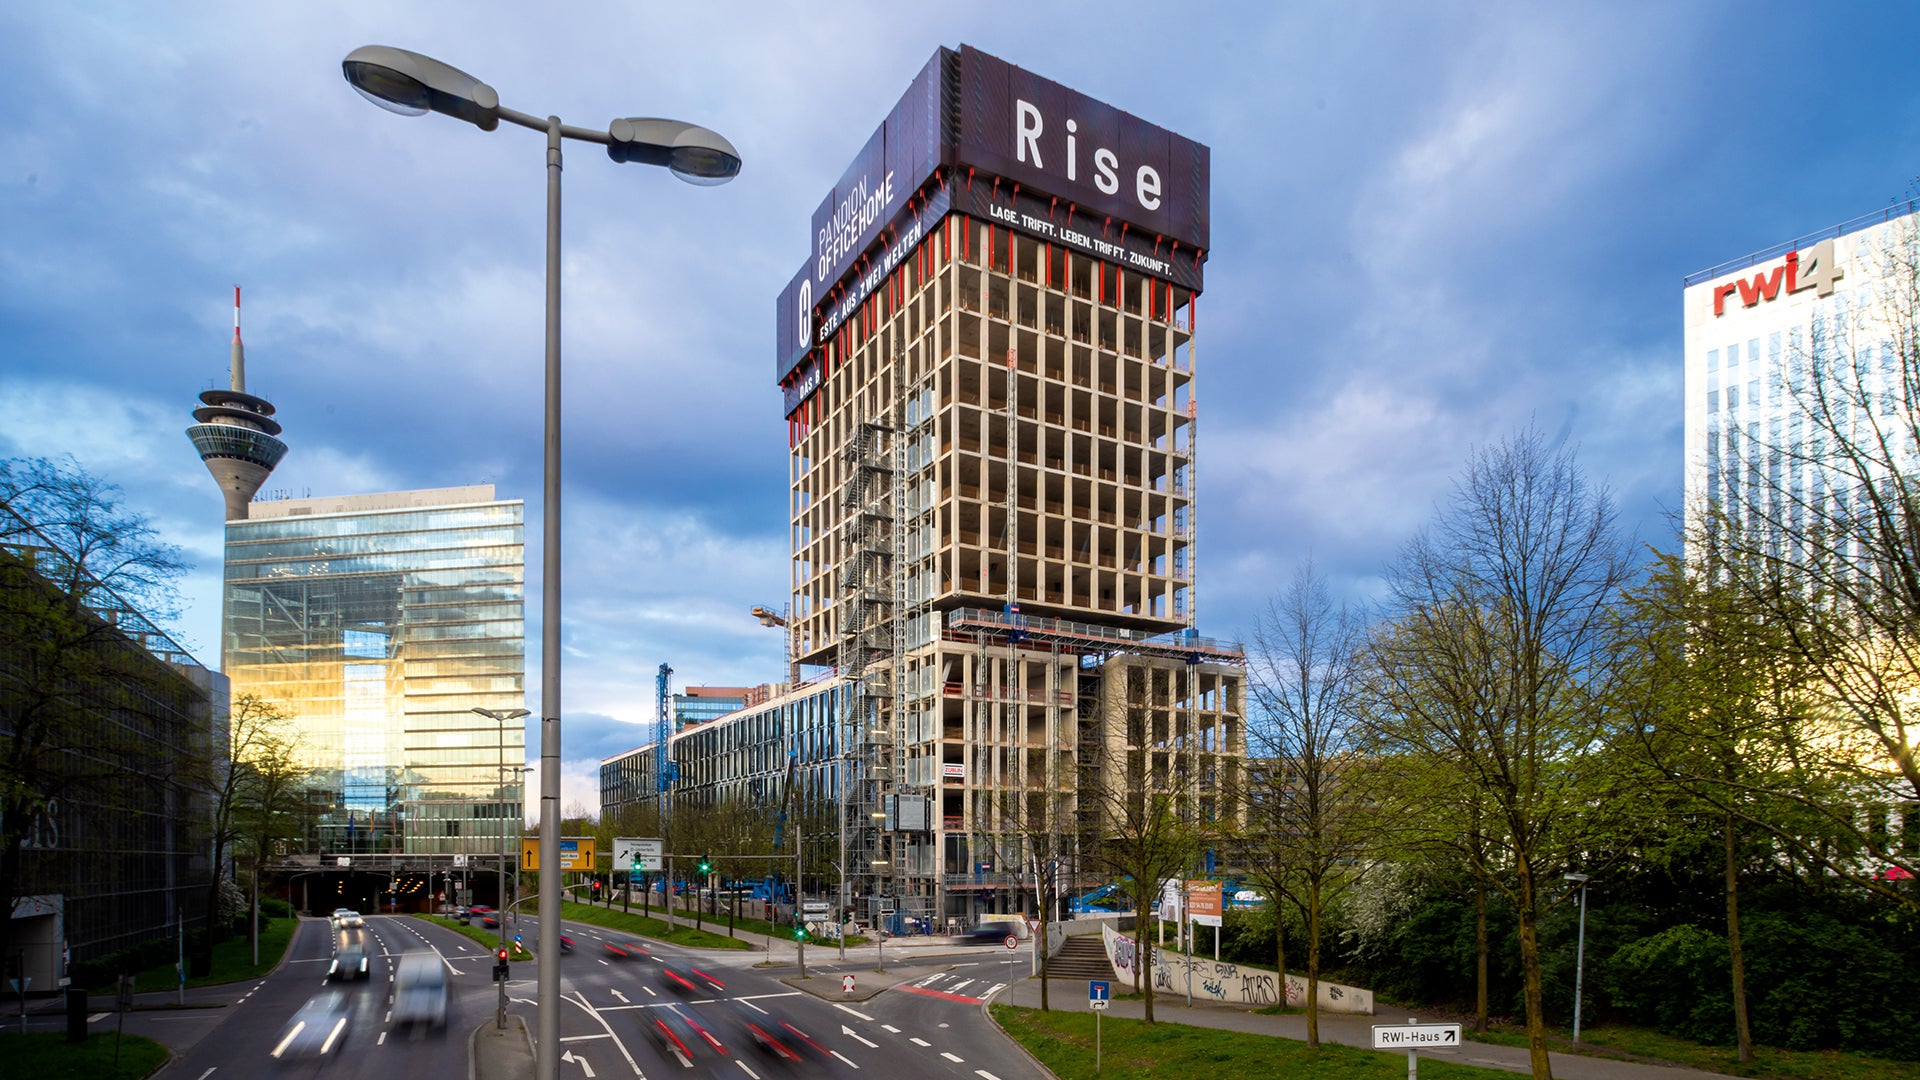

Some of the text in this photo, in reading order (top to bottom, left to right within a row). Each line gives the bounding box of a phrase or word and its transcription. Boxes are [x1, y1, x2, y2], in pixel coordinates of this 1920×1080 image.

[1016, 99, 1161, 211] Rise
[818, 174, 868, 255] PANDION
[818, 171, 894, 282] OFFICEHOME
[990, 204, 1172, 276] LAGE. TRIFFT. LEBEN. TRIFFT. ZUKUNFT.
[799, 378, 813, 400] DAS
[841, 292, 857, 319] AUS
[860, 271, 882, 300] ZWEI
[884, 221, 922, 271] WELTEN
[1713, 237, 1844, 317] rwi4
[1382, 1032, 1440, 1042] RWI-Haus
